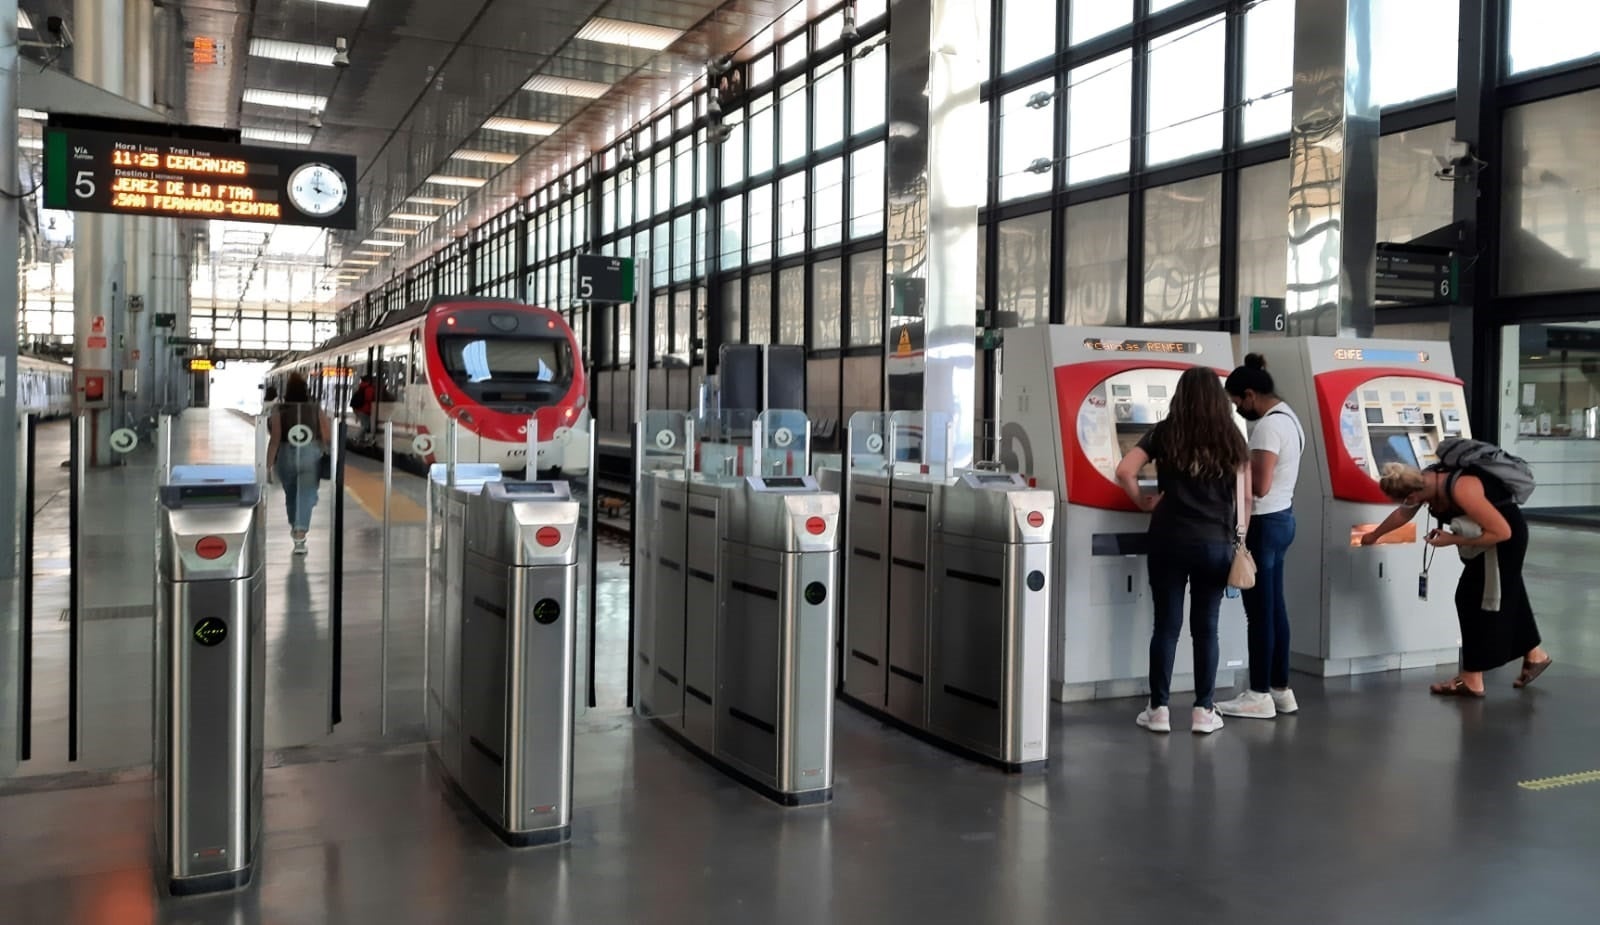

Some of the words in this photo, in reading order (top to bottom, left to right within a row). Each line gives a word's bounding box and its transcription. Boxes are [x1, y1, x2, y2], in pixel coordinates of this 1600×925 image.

[115, 142, 136, 151] Hora
[169, 146, 189, 155] Tren
[113, 151, 159, 167] 11:25
[166, 155, 246, 175] CERCANIAS
[115, 169, 148, 178] Destino
[75, 171, 96, 198] 5
[112, 178, 159, 193] JEREZ
[166, 181, 184, 195] DE
[192, 183, 211, 197] LA
[218, 185, 253, 200] FTRA
[581, 276, 593, 297] 5
[1441, 280, 1449, 296] 6
[1275, 314, 1284, 330] 6
[1146, 342, 1185, 353] RENFE
